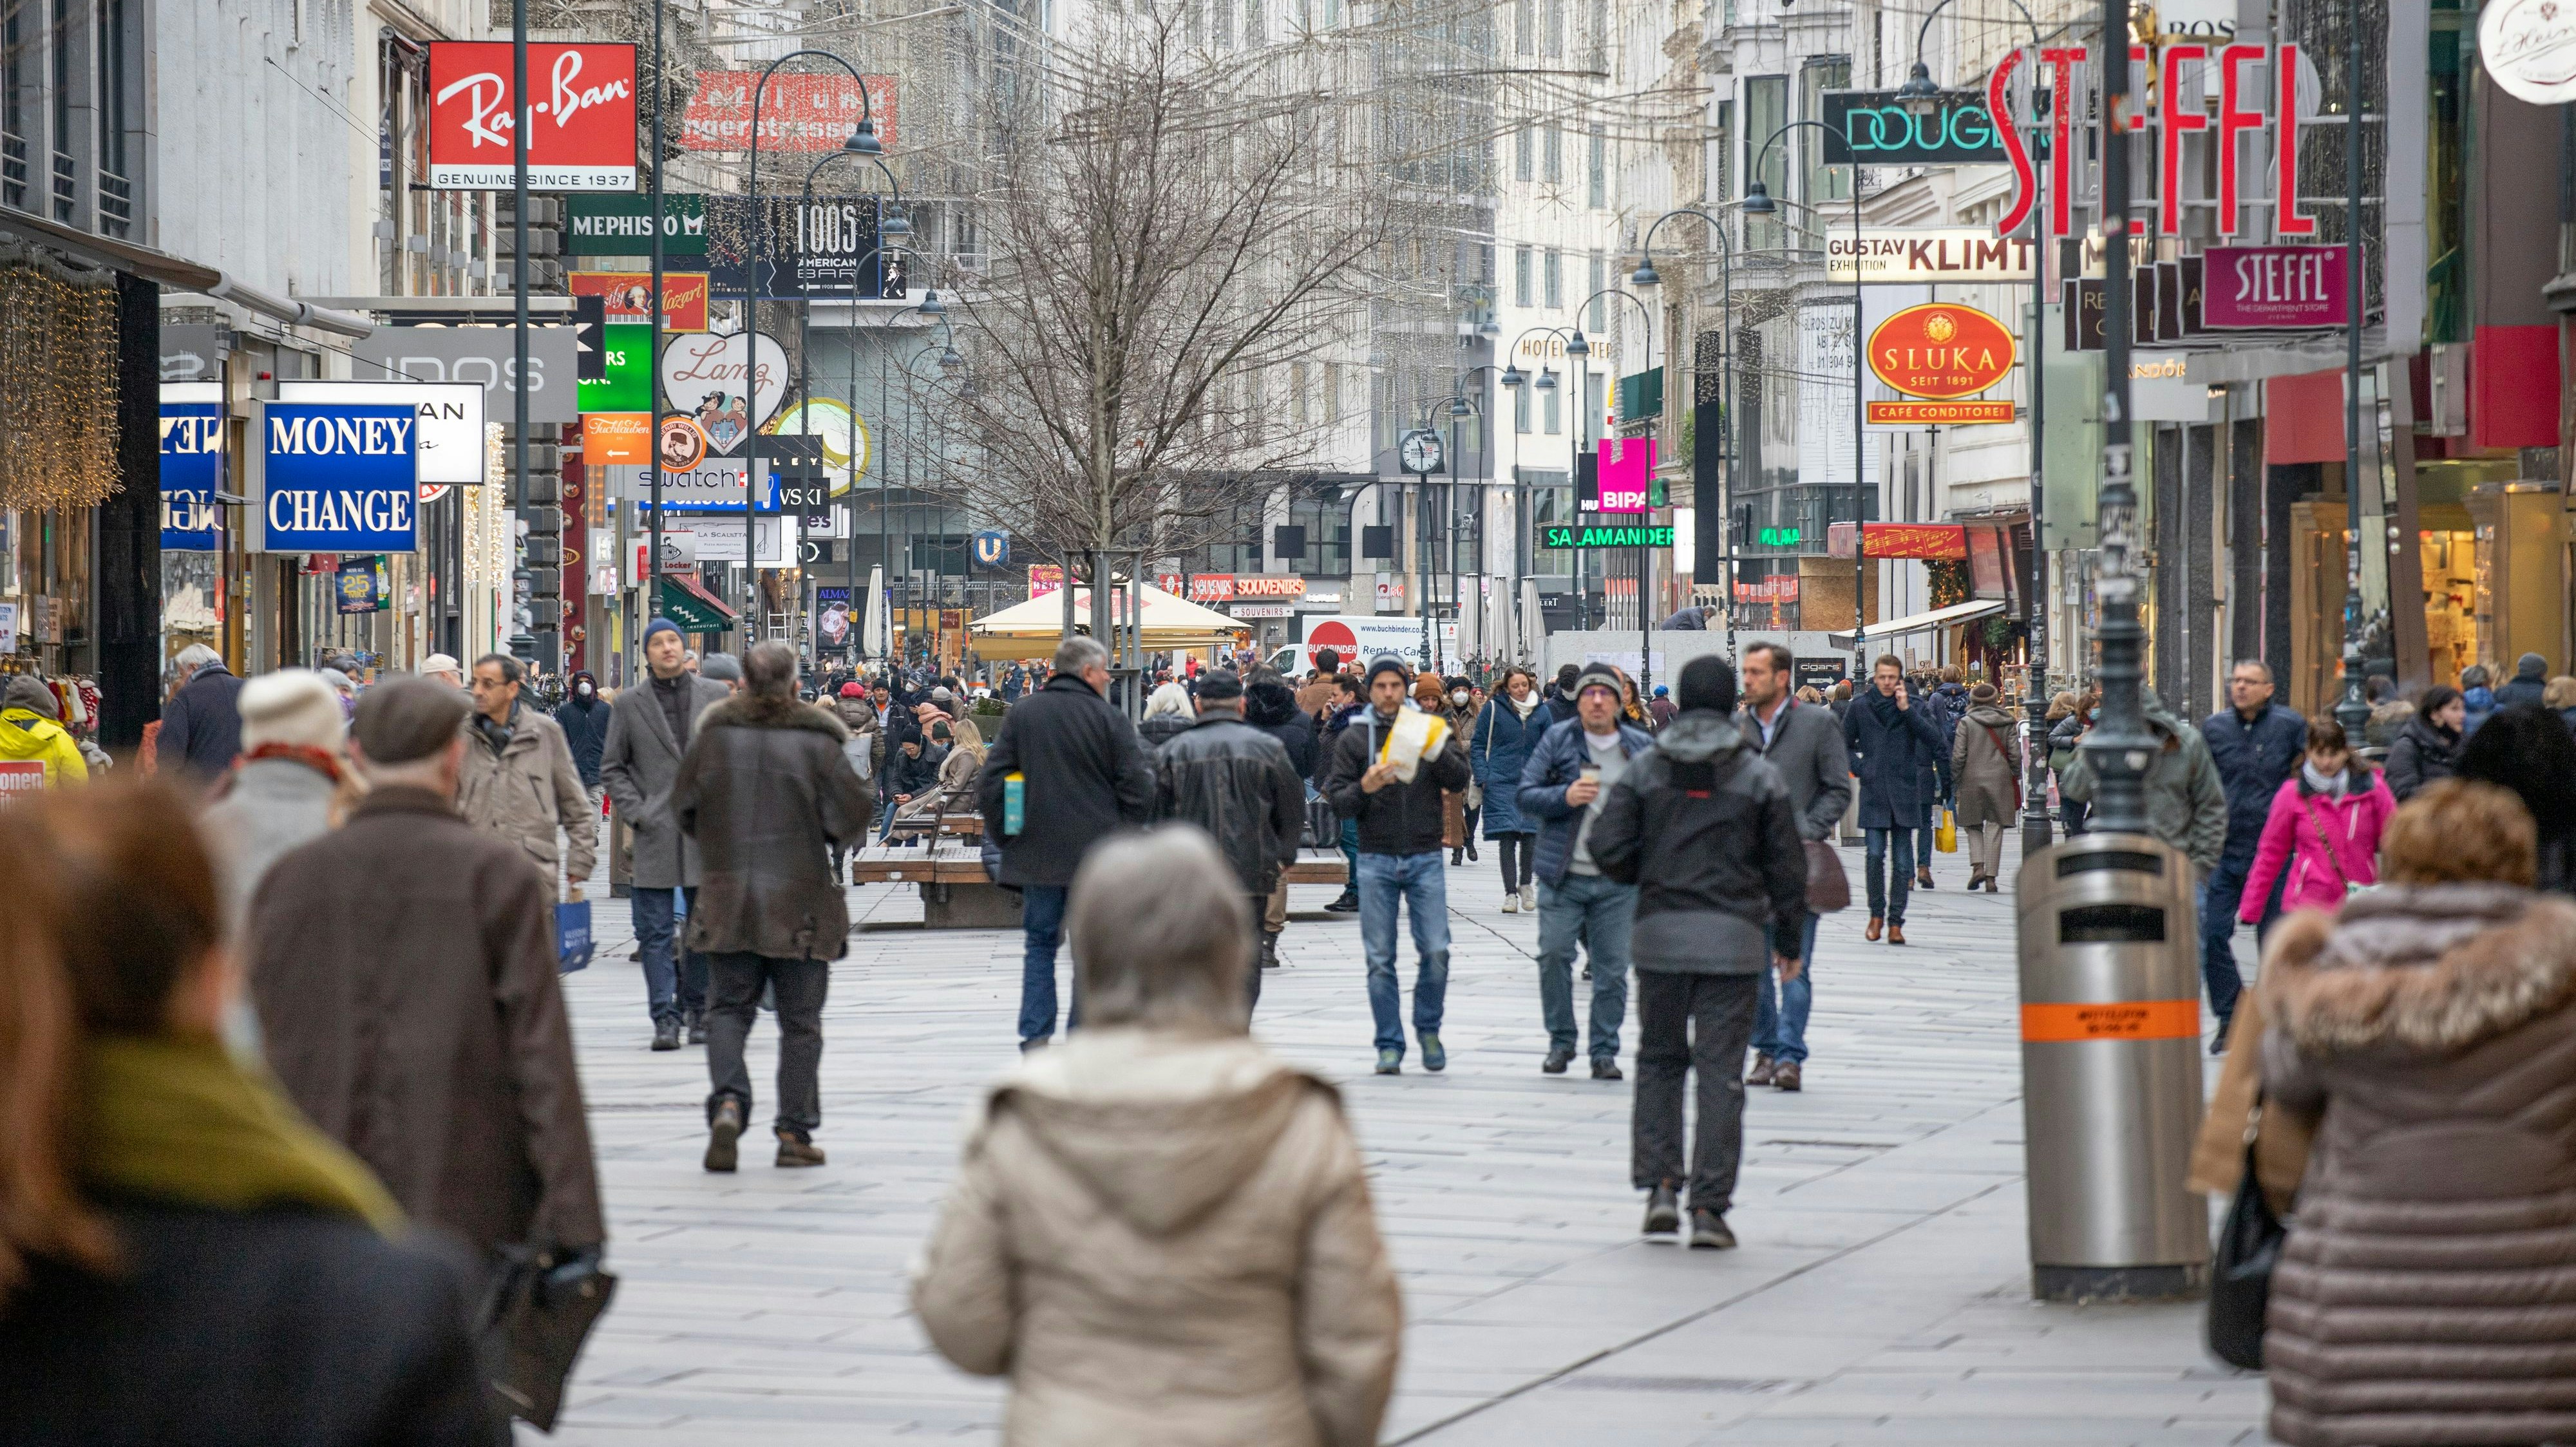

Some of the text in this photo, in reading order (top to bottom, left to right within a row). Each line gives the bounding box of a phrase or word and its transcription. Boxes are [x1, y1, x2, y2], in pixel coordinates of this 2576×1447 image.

[439, 174, 630, 186] GENUINE SINCE 1937
[573, 216, 679, 236] MEPHISO
[1829, 238, 2034, 270] GUSTAV KLIMT
[798, 258, 857, 268] AMERICAN
[1830, 260, 1886, 272] EXHIITION
[798, 269, 857, 279] BAR
[2235, 254, 2329, 301] STEFFL
[1830, 317, 1841, 330] ZU
[1522, 340, 1563, 356] HOTEL
[673, 340, 773, 397] Lanz
[1885, 348, 1996, 374] SLUKA
[1910, 375, 1973, 386] SEIT 1891
[1878, 406, 2005, 418] CAFÉ CONDITOREI
[588, 417, 650, 435] Tuchlauben
[678, 423, 698, 439] WILLIG
[269, 417, 413, 455] MONEY
[638, 468, 735, 488] swatch
[1603, 491, 1647, 509] BIPA
[269, 489, 412, 531] CHANGE
[978, 538, 1001, 563] U
[343, 574, 370, 594] 25
[1195, 579, 1232, 595] SOUVENIRS
[1238, 578, 1305, 595] SOUVENIRS
[1241, 607, 1283, 616] SOUVENIRS
[1307, 644, 1358, 654] BUCHBINDER
[1801, 663, 1840, 672] cigars
